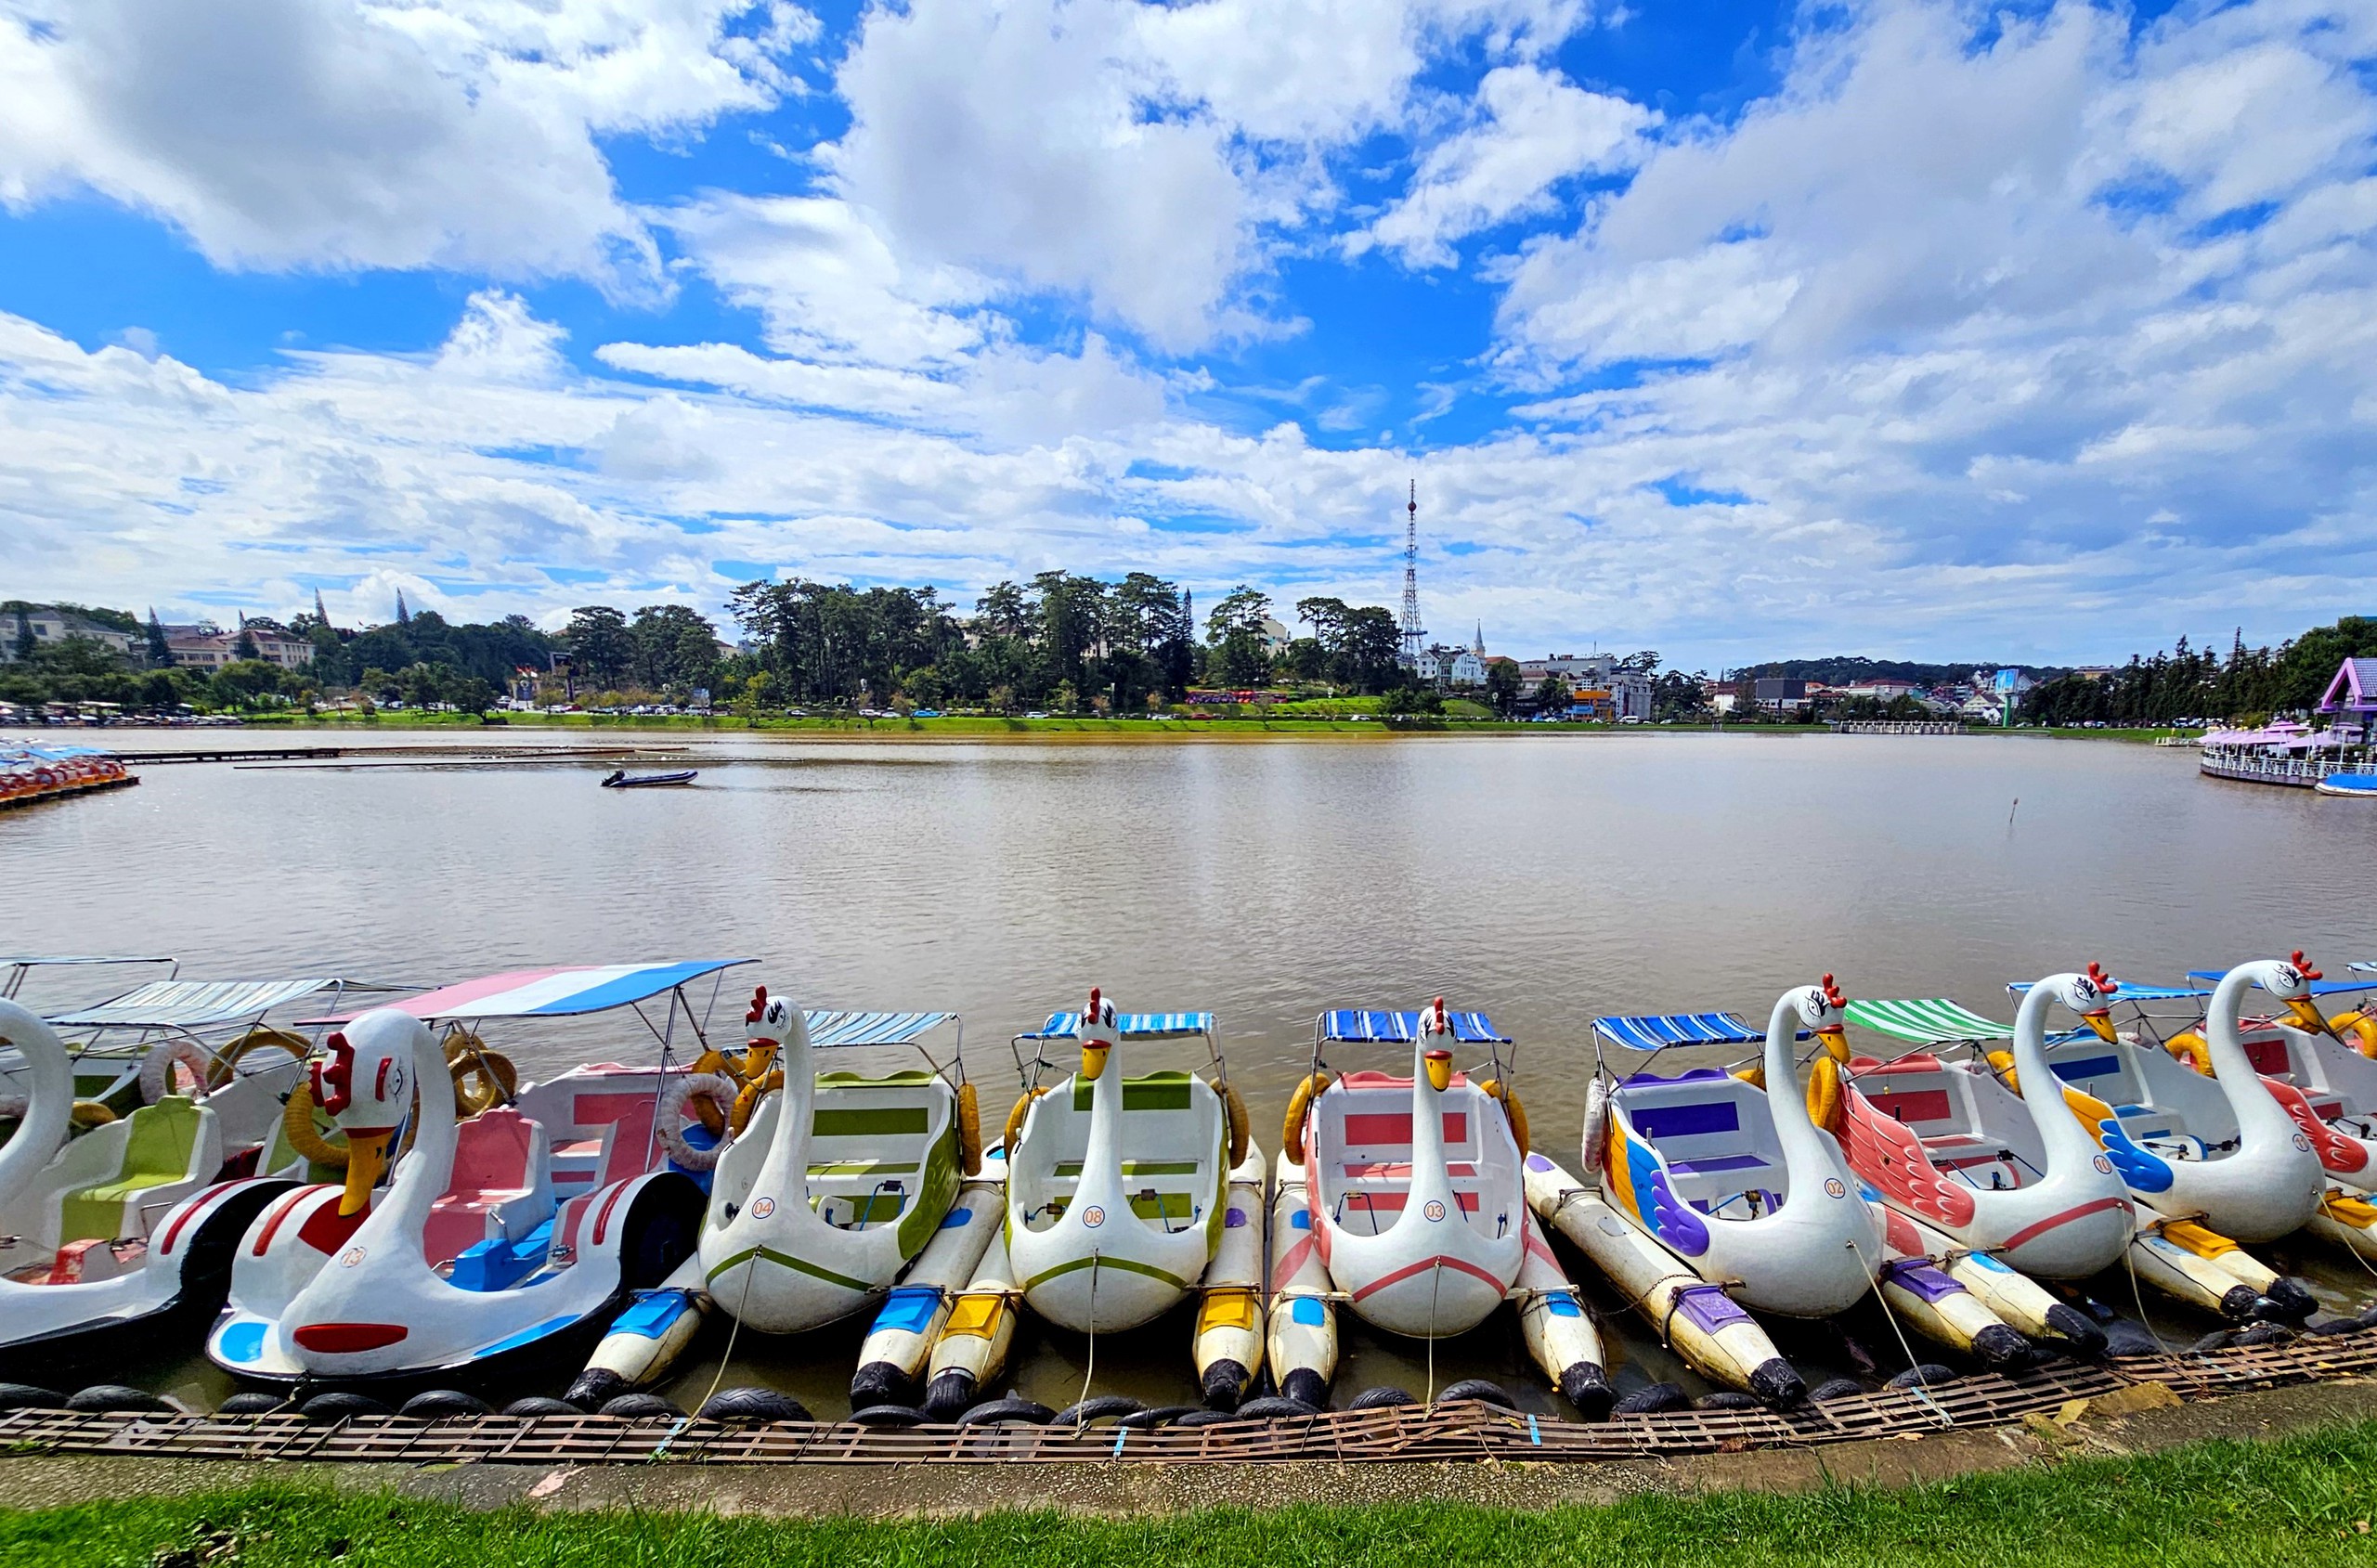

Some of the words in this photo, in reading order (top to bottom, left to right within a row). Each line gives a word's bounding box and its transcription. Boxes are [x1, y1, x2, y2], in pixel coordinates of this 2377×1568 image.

[2096, 1159, 2111, 1172] 10
[1826, 1182, 1843, 1195] 02
[754, 1201, 772, 1214] 04
[1426, 1204, 1443, 1217] 03
[1085, 1211, 1102, 1224] 08
[344, 1251, 364, 1264] 13
